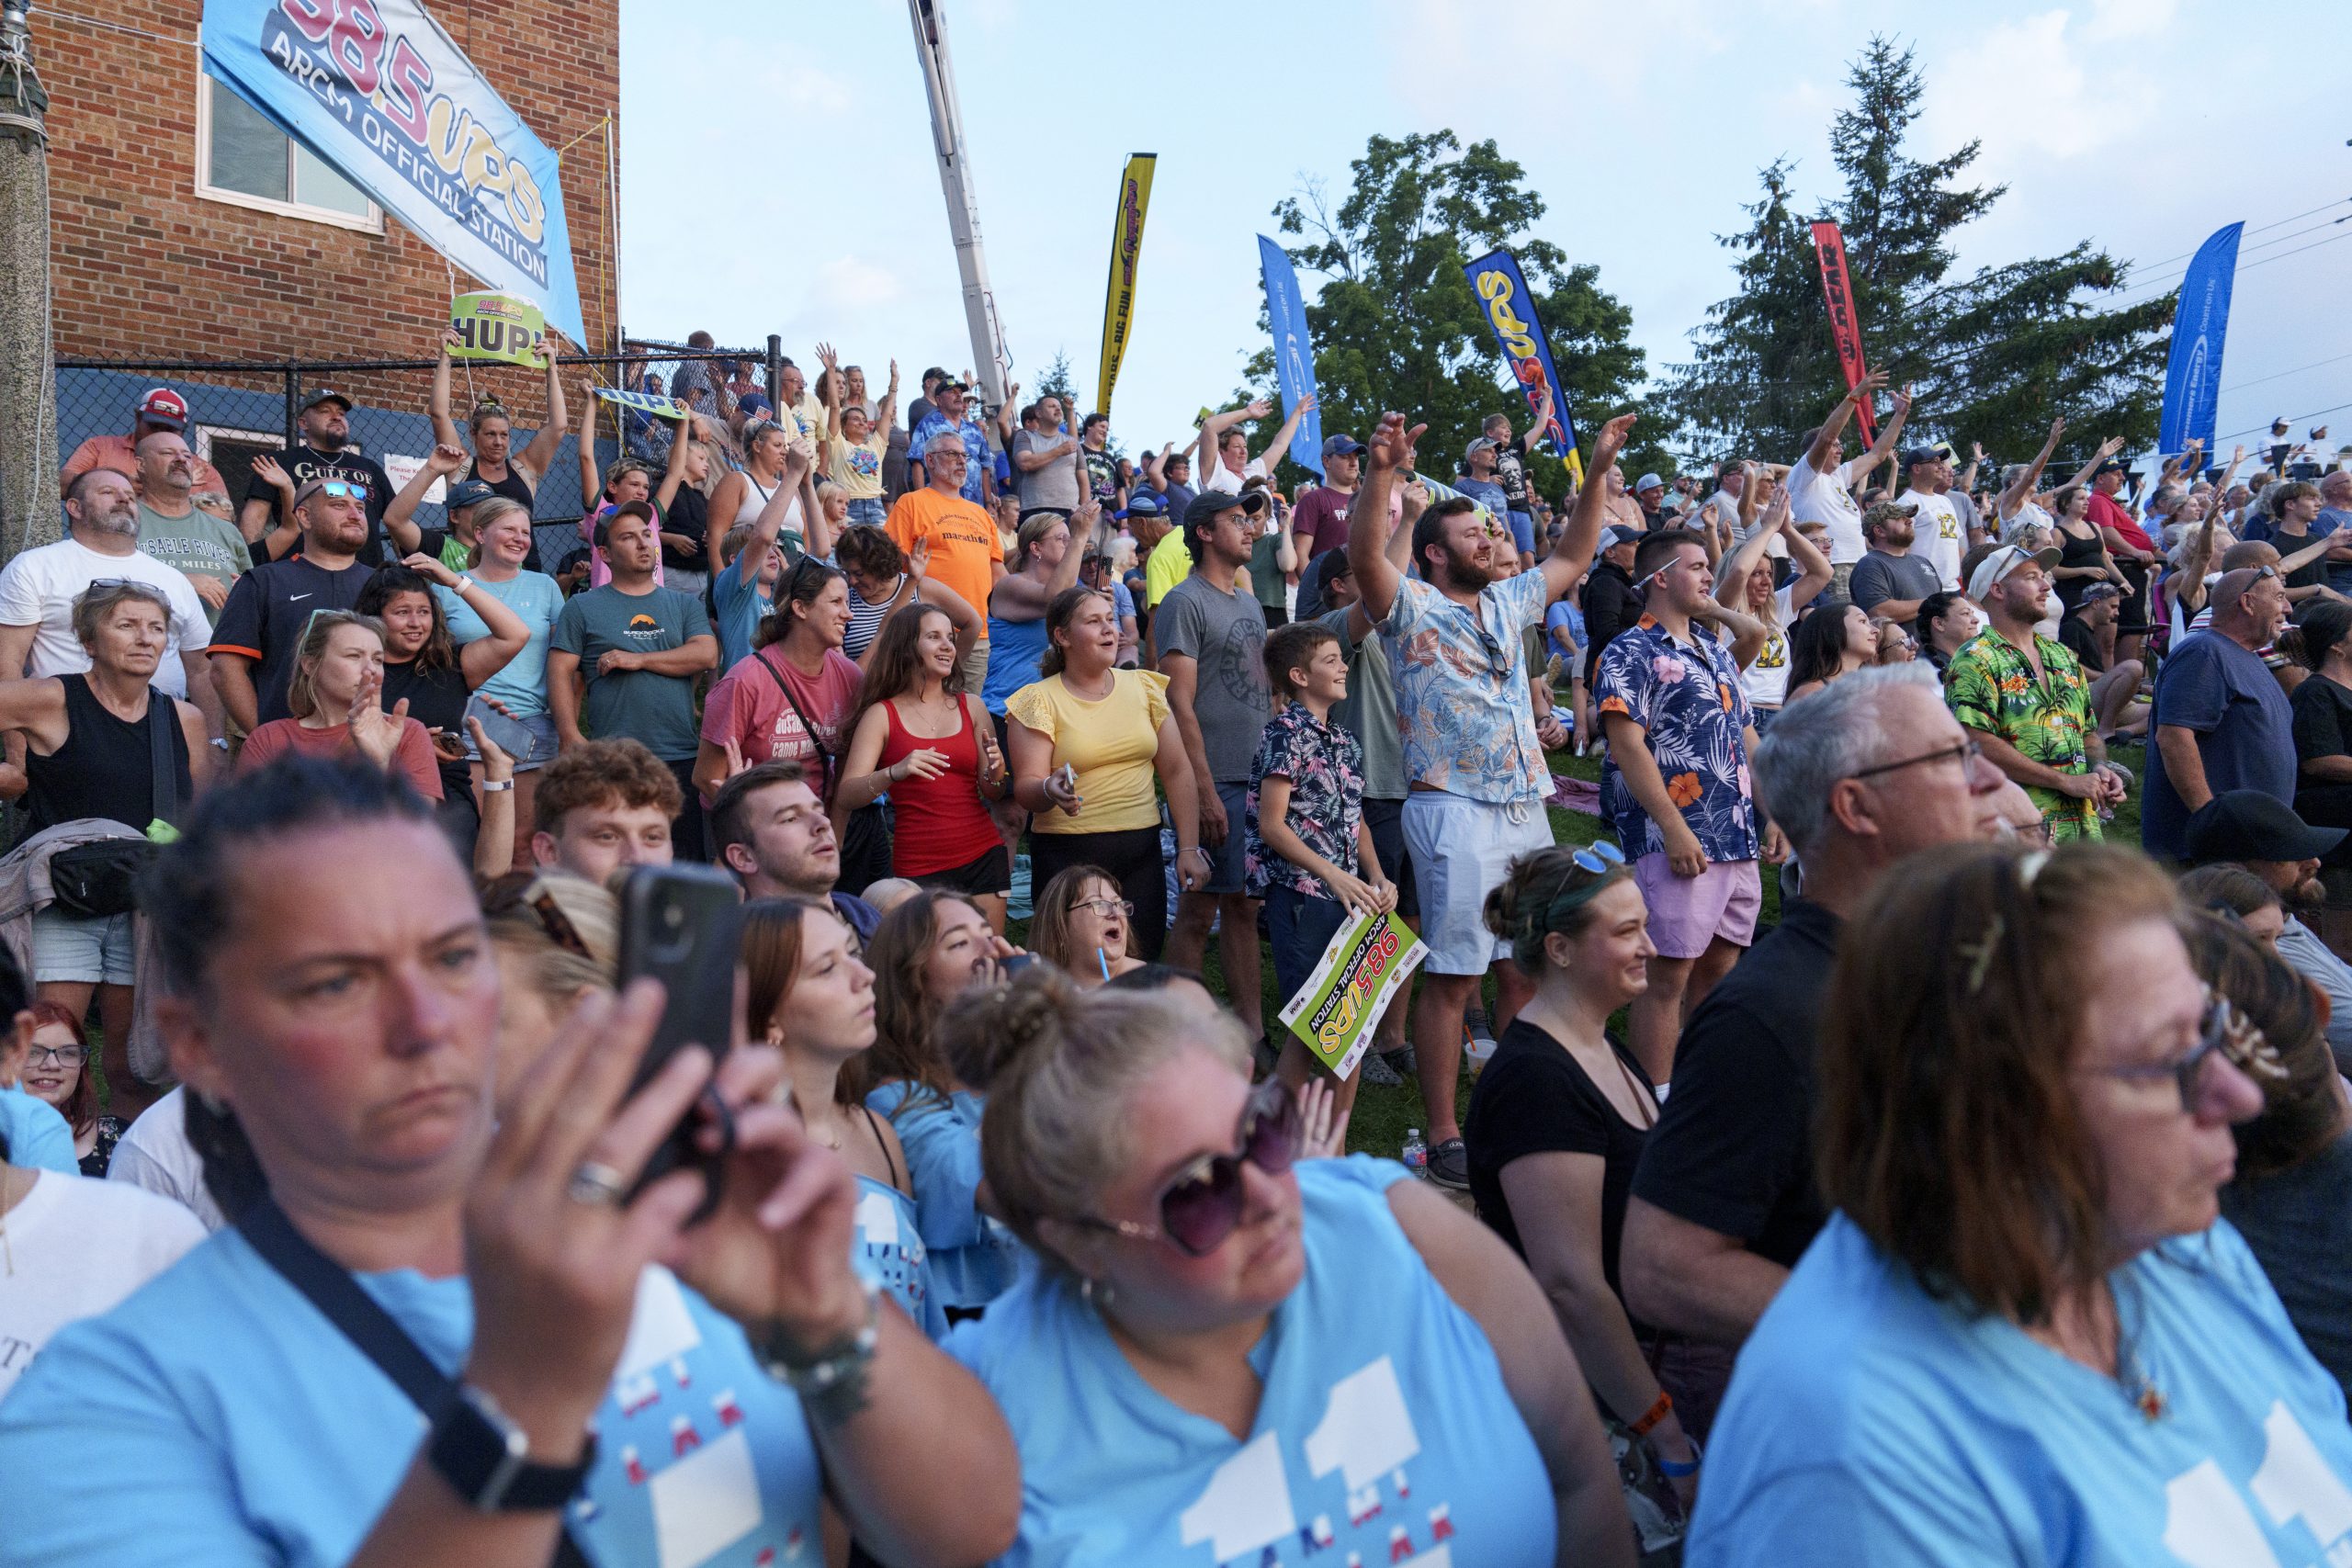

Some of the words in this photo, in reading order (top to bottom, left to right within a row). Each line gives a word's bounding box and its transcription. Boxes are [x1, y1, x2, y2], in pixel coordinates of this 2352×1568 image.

[270, 30, 354, 123] ARCM
[361, 112, 466, 222] OFFICIAL
[469, 202, 546, 284] STATION
[1117, 289, 1132, 318] FUN
[1476, 270, 1537, 359] UPS
[2199, 305, 2211, 333] Count
[2206, 293, 2213, 304] on
[453, 317, 542, 362] HUP!
[1114, 321, 1126, 344] BIG
[2190, 349, 2204, 389] Energy
[294, 462, 349, 481] GULF
[353, 471, 373, 485] OF
[942, 532, 989, 547] marathon
[1937, 513, 1958, 539] 12
[182, 560, 221, 570] MILES
[192, 538, 232, 565] RIVER
[1363, 914, 1386, 945] ARCM
[1338, 944, 1367, 989] OFFICIAL
[1311, 988, 1341, 1032] STATION
[1317, 980, 1363, 1055] UPS
